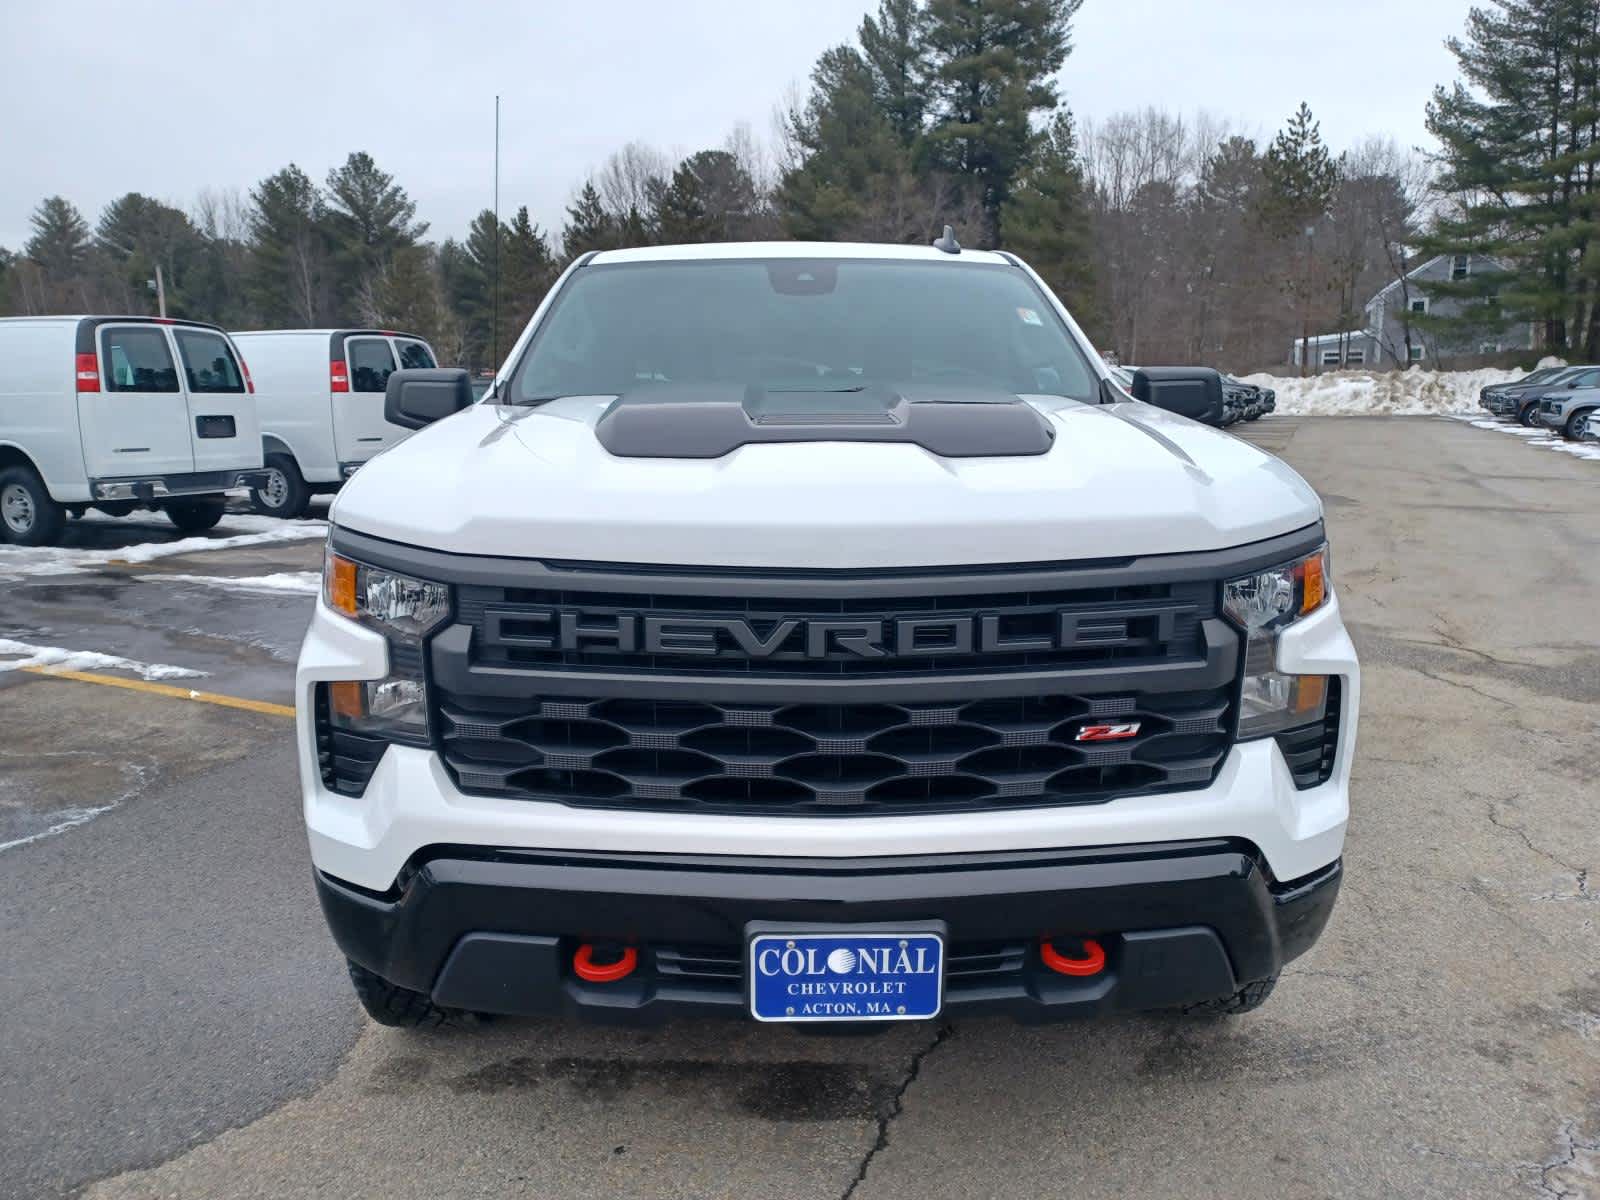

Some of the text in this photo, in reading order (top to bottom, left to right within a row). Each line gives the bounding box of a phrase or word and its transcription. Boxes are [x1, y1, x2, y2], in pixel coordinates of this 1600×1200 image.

[483, 604, 1200, 658] CHEVROLET
[787, 982, 906, 995] CHEVROLET
[802, 1002, 891, 1015] ACTON, MA
